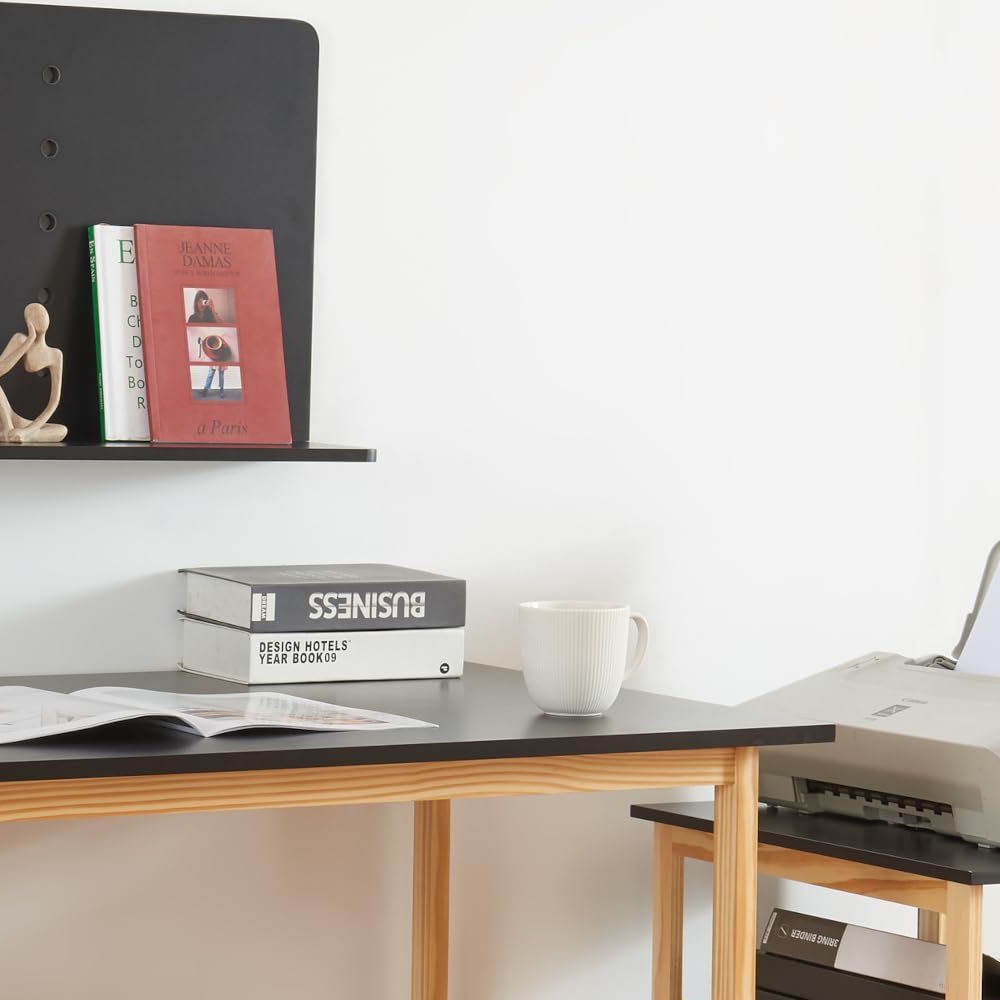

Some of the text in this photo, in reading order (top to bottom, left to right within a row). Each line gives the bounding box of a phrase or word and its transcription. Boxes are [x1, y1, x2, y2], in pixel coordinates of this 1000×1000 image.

[116, 239, 136, 264] E
[178, 240, 232, 255] JEANNE
[182, 255, 232, 268] DAMAS
[130, 295, 138, 307] B
[132, 336, 142, 348] D
[126, 356, 143, 368] To
[128, 376, 145, 389] Bo
[211, 419, 248, 436] Paris
[308, 591, 426, 620] BUSINESS
[259, 640, 348, 653] DESIGN HOTELS
[259, 653, 288, 665] YEAR
[790, 928, 817, 943] BINDER
